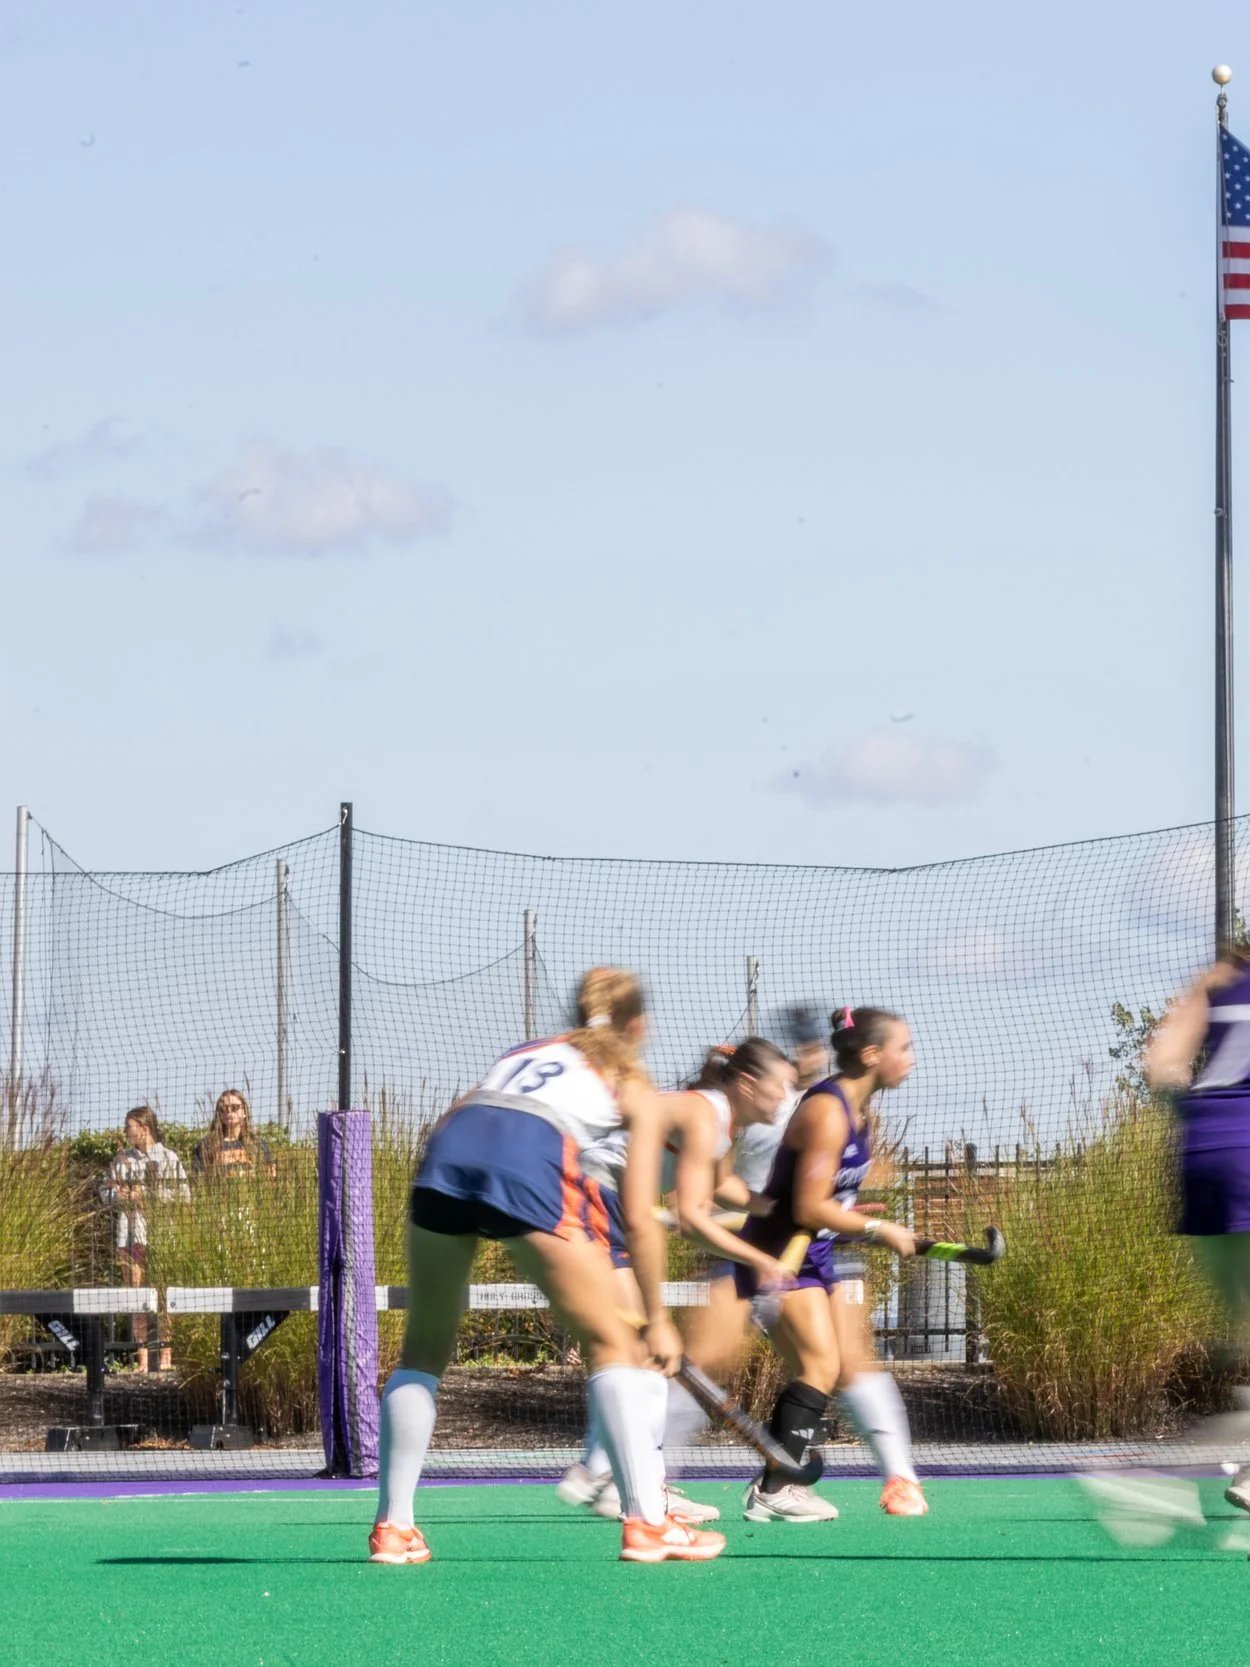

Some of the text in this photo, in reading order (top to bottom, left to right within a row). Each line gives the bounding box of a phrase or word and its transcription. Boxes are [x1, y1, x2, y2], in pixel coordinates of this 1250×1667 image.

[501, 1057, 565, 1094] 13
[48, 1320, 80, 1351] GILL
[247, 1315, 276, 1349] GILL
